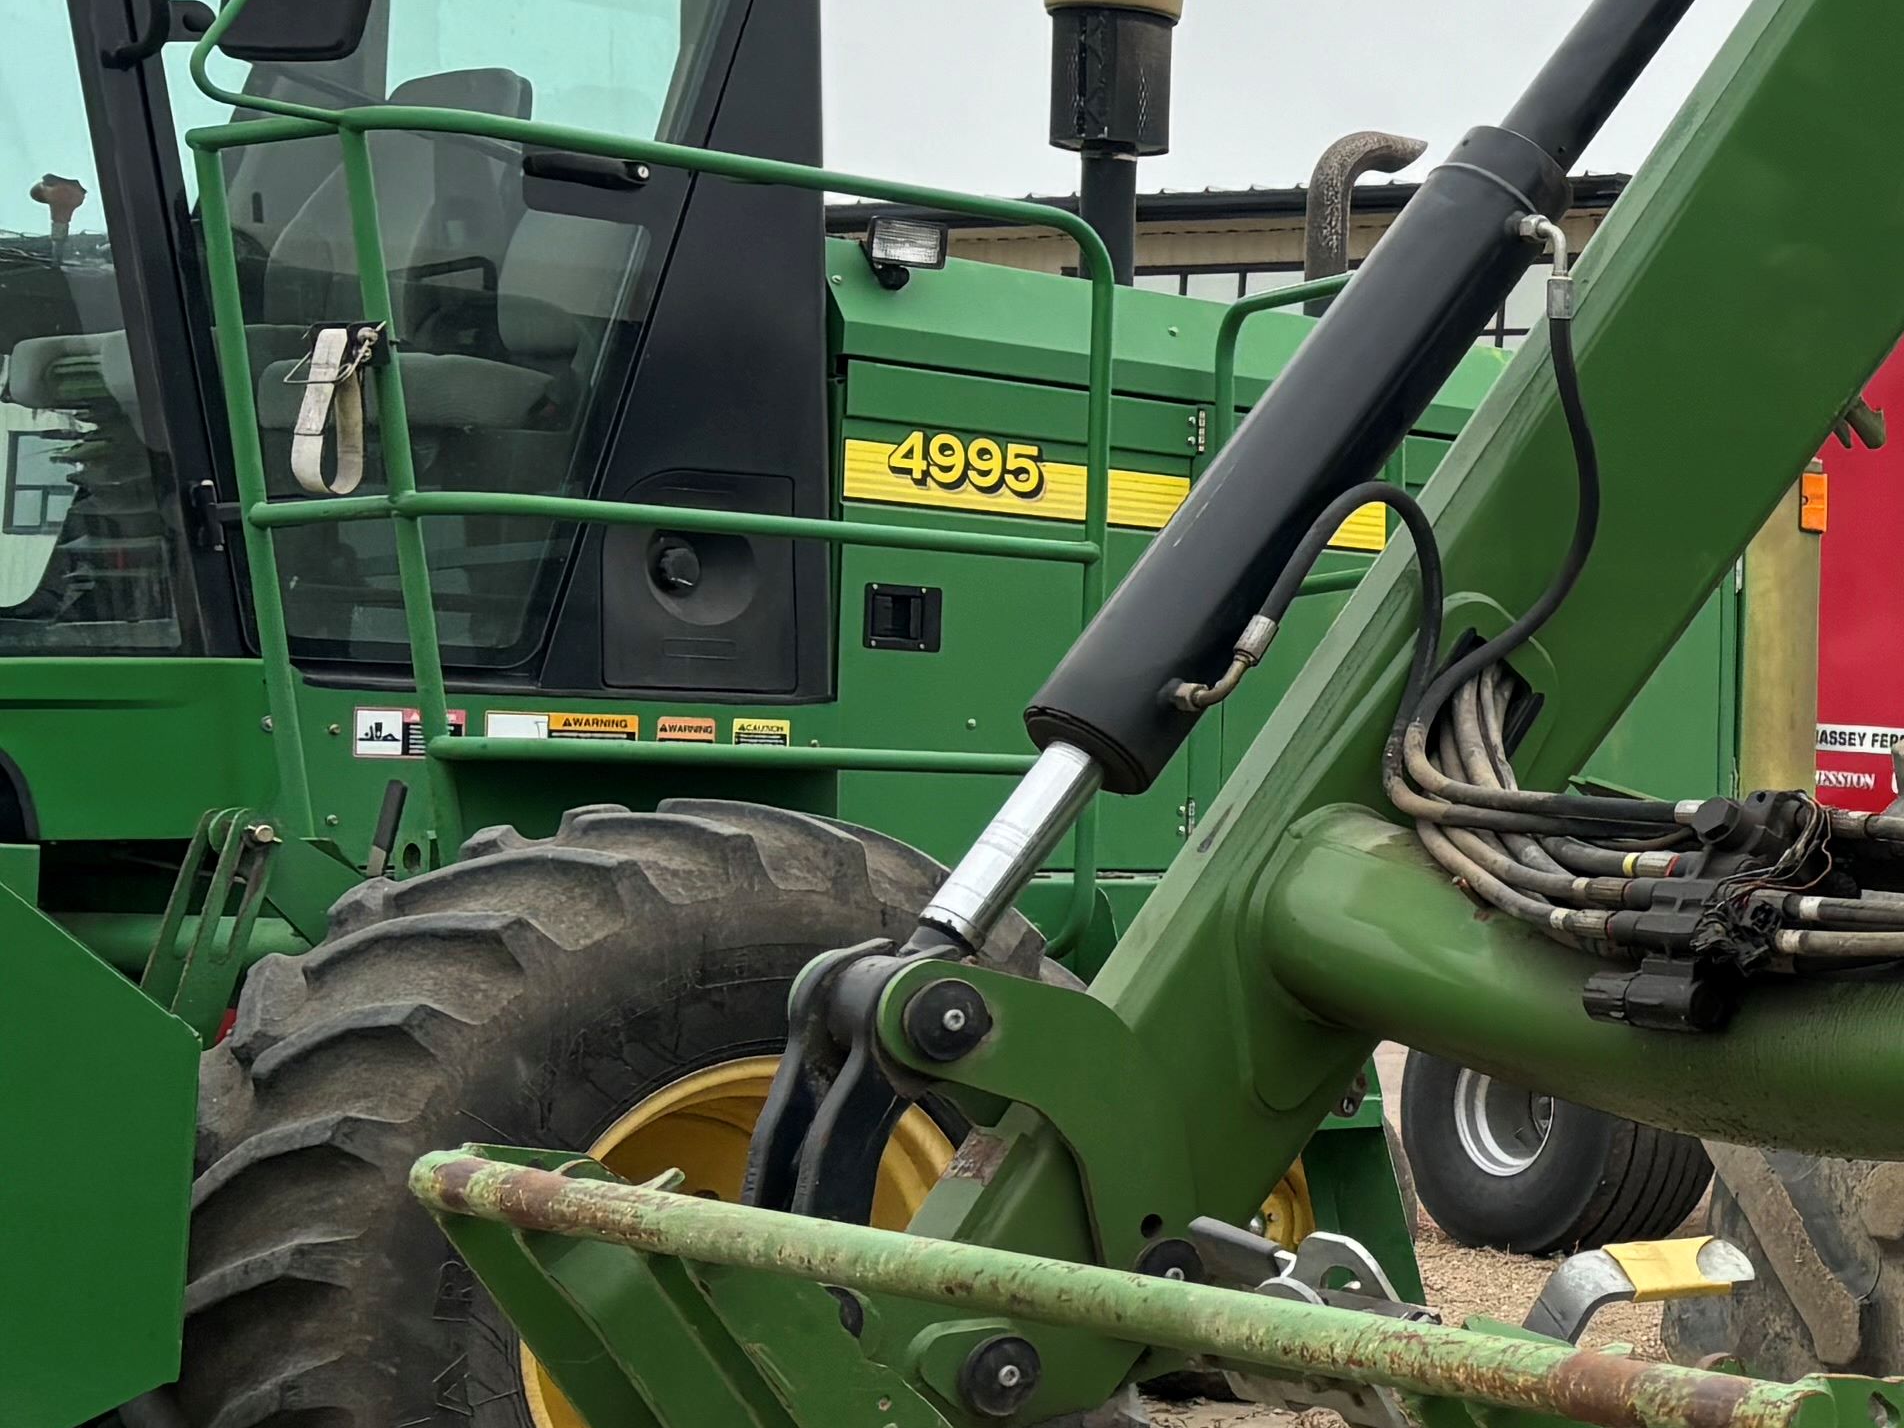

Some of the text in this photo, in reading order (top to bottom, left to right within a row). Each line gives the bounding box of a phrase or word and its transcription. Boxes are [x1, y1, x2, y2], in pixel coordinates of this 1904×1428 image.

[888, 429, 1045, 500] 4995
[572, 716, 628, 729] WARNING
[667, 724, 713, 735] WARNING
[1816, 729, 1867, 747] ASSEY
